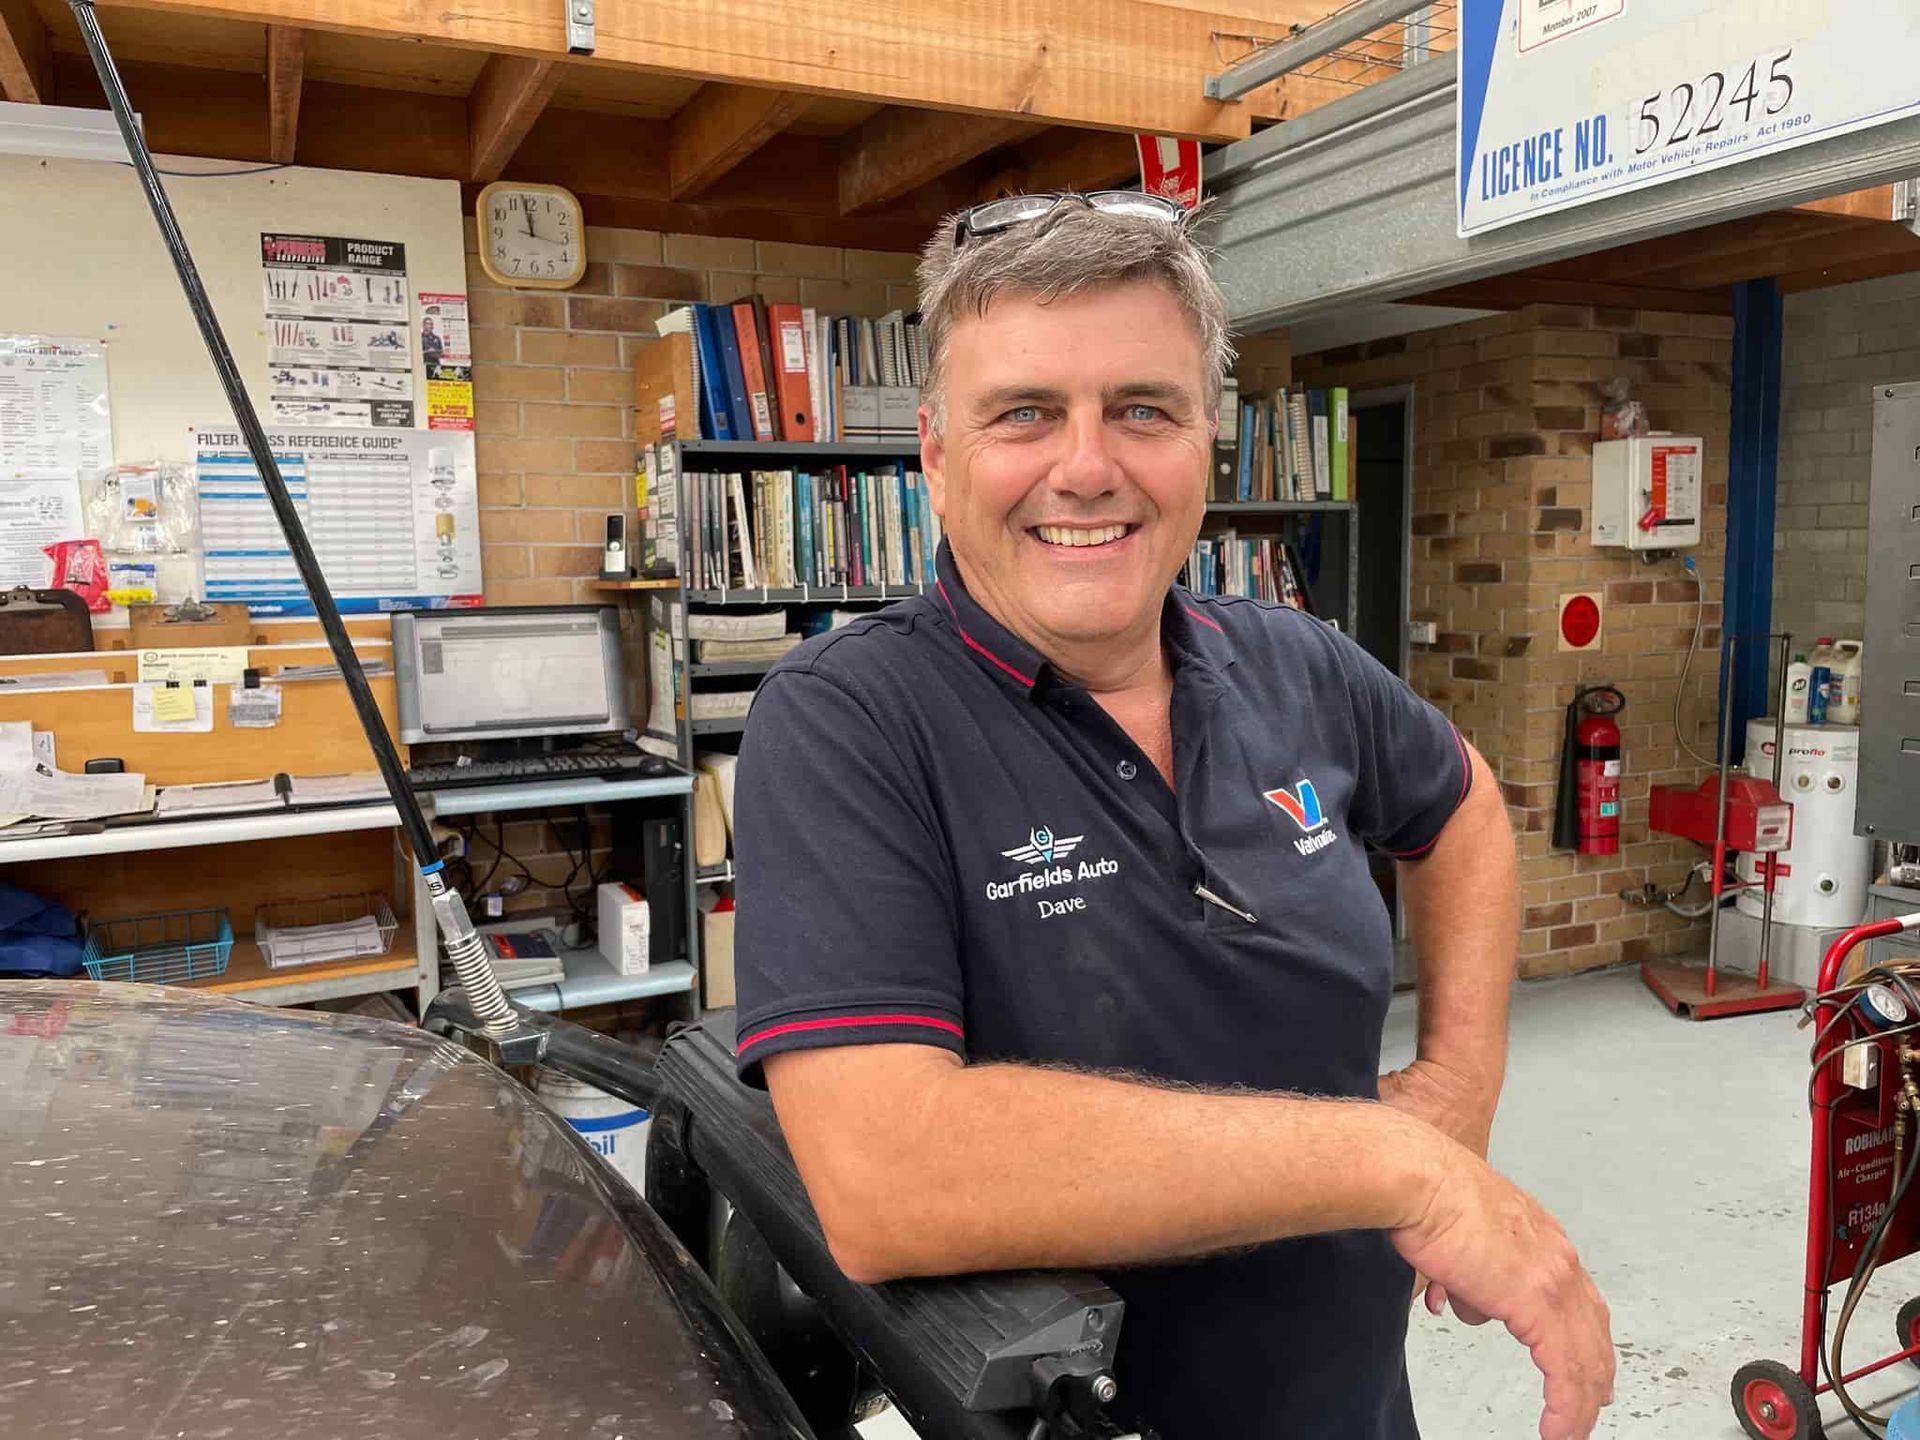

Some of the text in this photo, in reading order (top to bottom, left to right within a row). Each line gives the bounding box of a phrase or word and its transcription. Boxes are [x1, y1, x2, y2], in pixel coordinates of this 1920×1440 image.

[1542, 5, 1598, 35] Member 2007
[1636, 47, 1793, 155] 52245
[1482, 114, 1613, 201] LICENCE NO.
[1530, 114, 1812, 202] In Compliance with Motor Vehicle Repairs Act 1980
[347, 242, 394, 256] PRODUCT
[347, 253, 383, 266] RANGE
[197, 433, 239, 447] FILTER
[288, 435, 359, 448] REFERENCE
[986, 857, 1119, 900] Garfields Auto
[1037, 896, 1087, 919] Dave
[1844, 1125, 1896, 1156] ROBINAI
[1855, 1167, 1887, 1184] Charger
